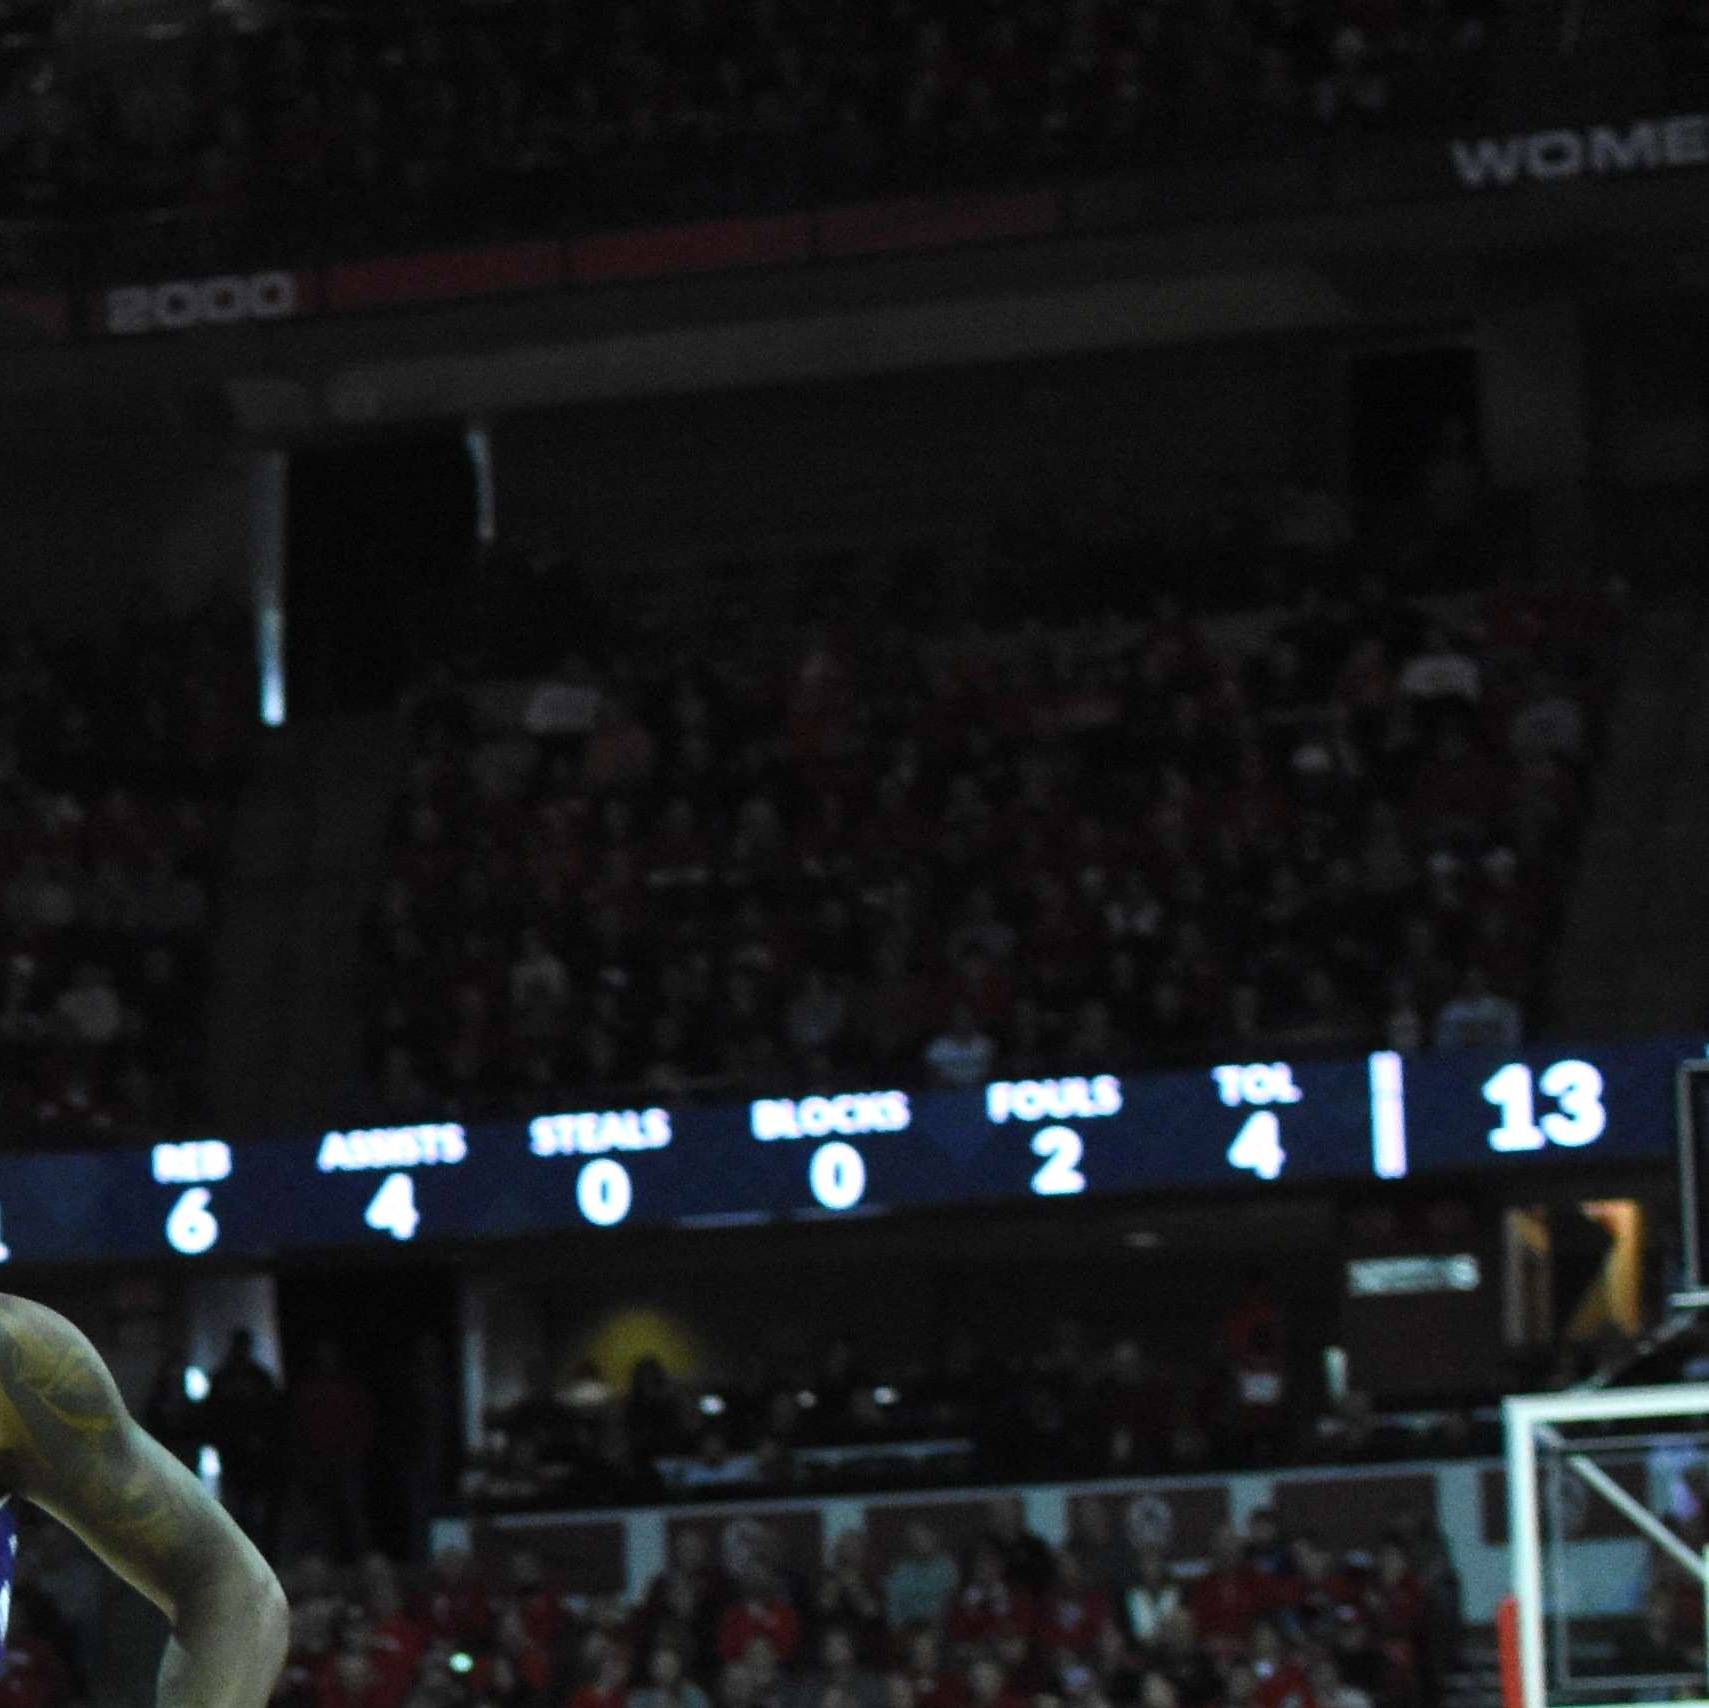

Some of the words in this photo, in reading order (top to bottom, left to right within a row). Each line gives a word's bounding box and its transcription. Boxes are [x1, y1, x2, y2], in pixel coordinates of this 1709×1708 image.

[106, 272, 296, 333] 2000
[529, 1108, 672, 1157] STEALS
[751, 1089, 911, 1140] BLOCKS
[986, 1074, 1122, 1124] FOULS
[1213, 1062, 1302, 1107] TOL
[1483, 1059, 1606, 1152] 13
[165, 1186, 218, 1254] 6
[364, 1172, 419, 1240] 4
[577, 1158, 632, 1226] 0
[810, 1141, 866, 1210] 0
[1032, 1125, 1085, 1195] 2
[1227, 1110, 1285, 1179] 4
